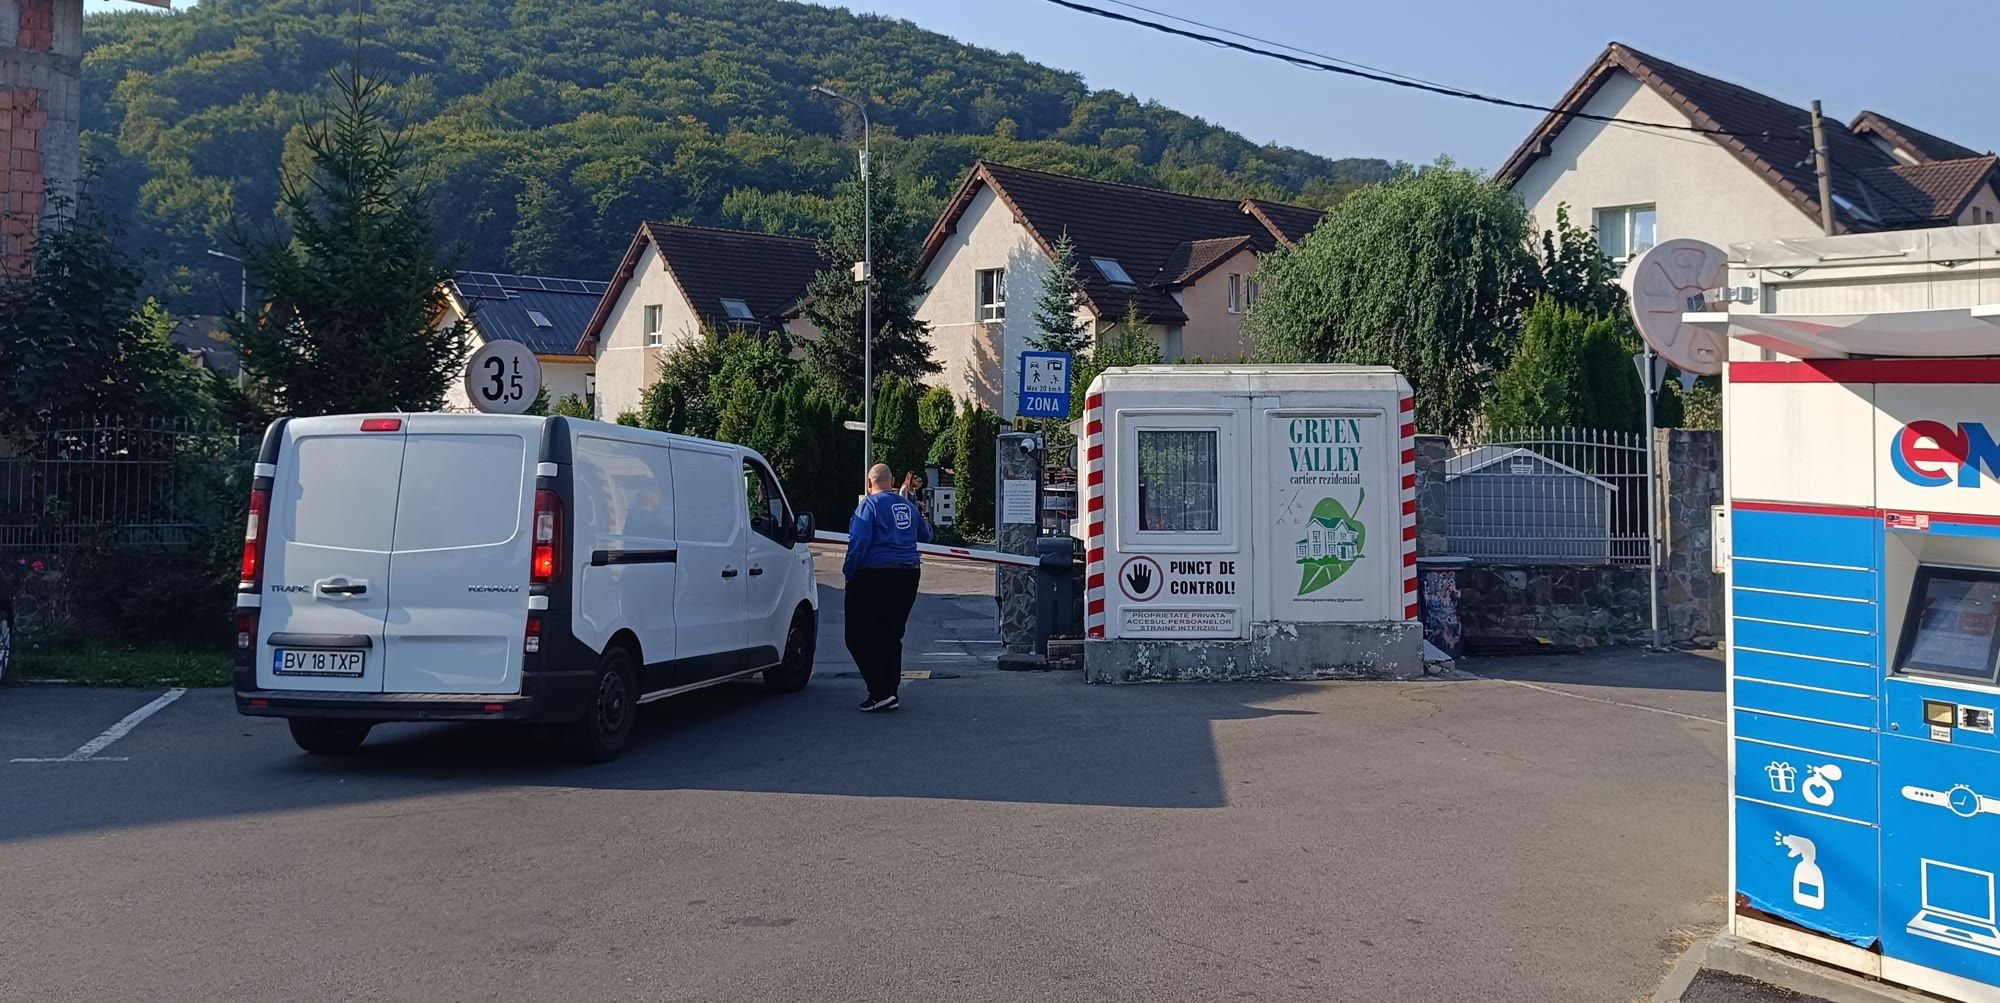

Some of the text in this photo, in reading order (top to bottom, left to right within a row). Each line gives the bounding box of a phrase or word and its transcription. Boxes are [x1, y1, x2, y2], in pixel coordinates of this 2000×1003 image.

[1026, 396, 1060, 412] ZONA
[1289, 418, 1361, 444] GREEN
[1288, 446, 1363, 472] VALLEY
[1289, 473, 1360, 485] cartier rezidential
[1170, 561, 1235, 575] PUNCT DE
[270, 585, 311, 593] TRAFIC
[468, 585, 521, 593] RENAULT
[1170, 581, 1236, 595] CONTROL!
[284, 652, 307, 669] BV
[312, 653, 326, 670] 18
[329, 654, 360, 670] TXP
